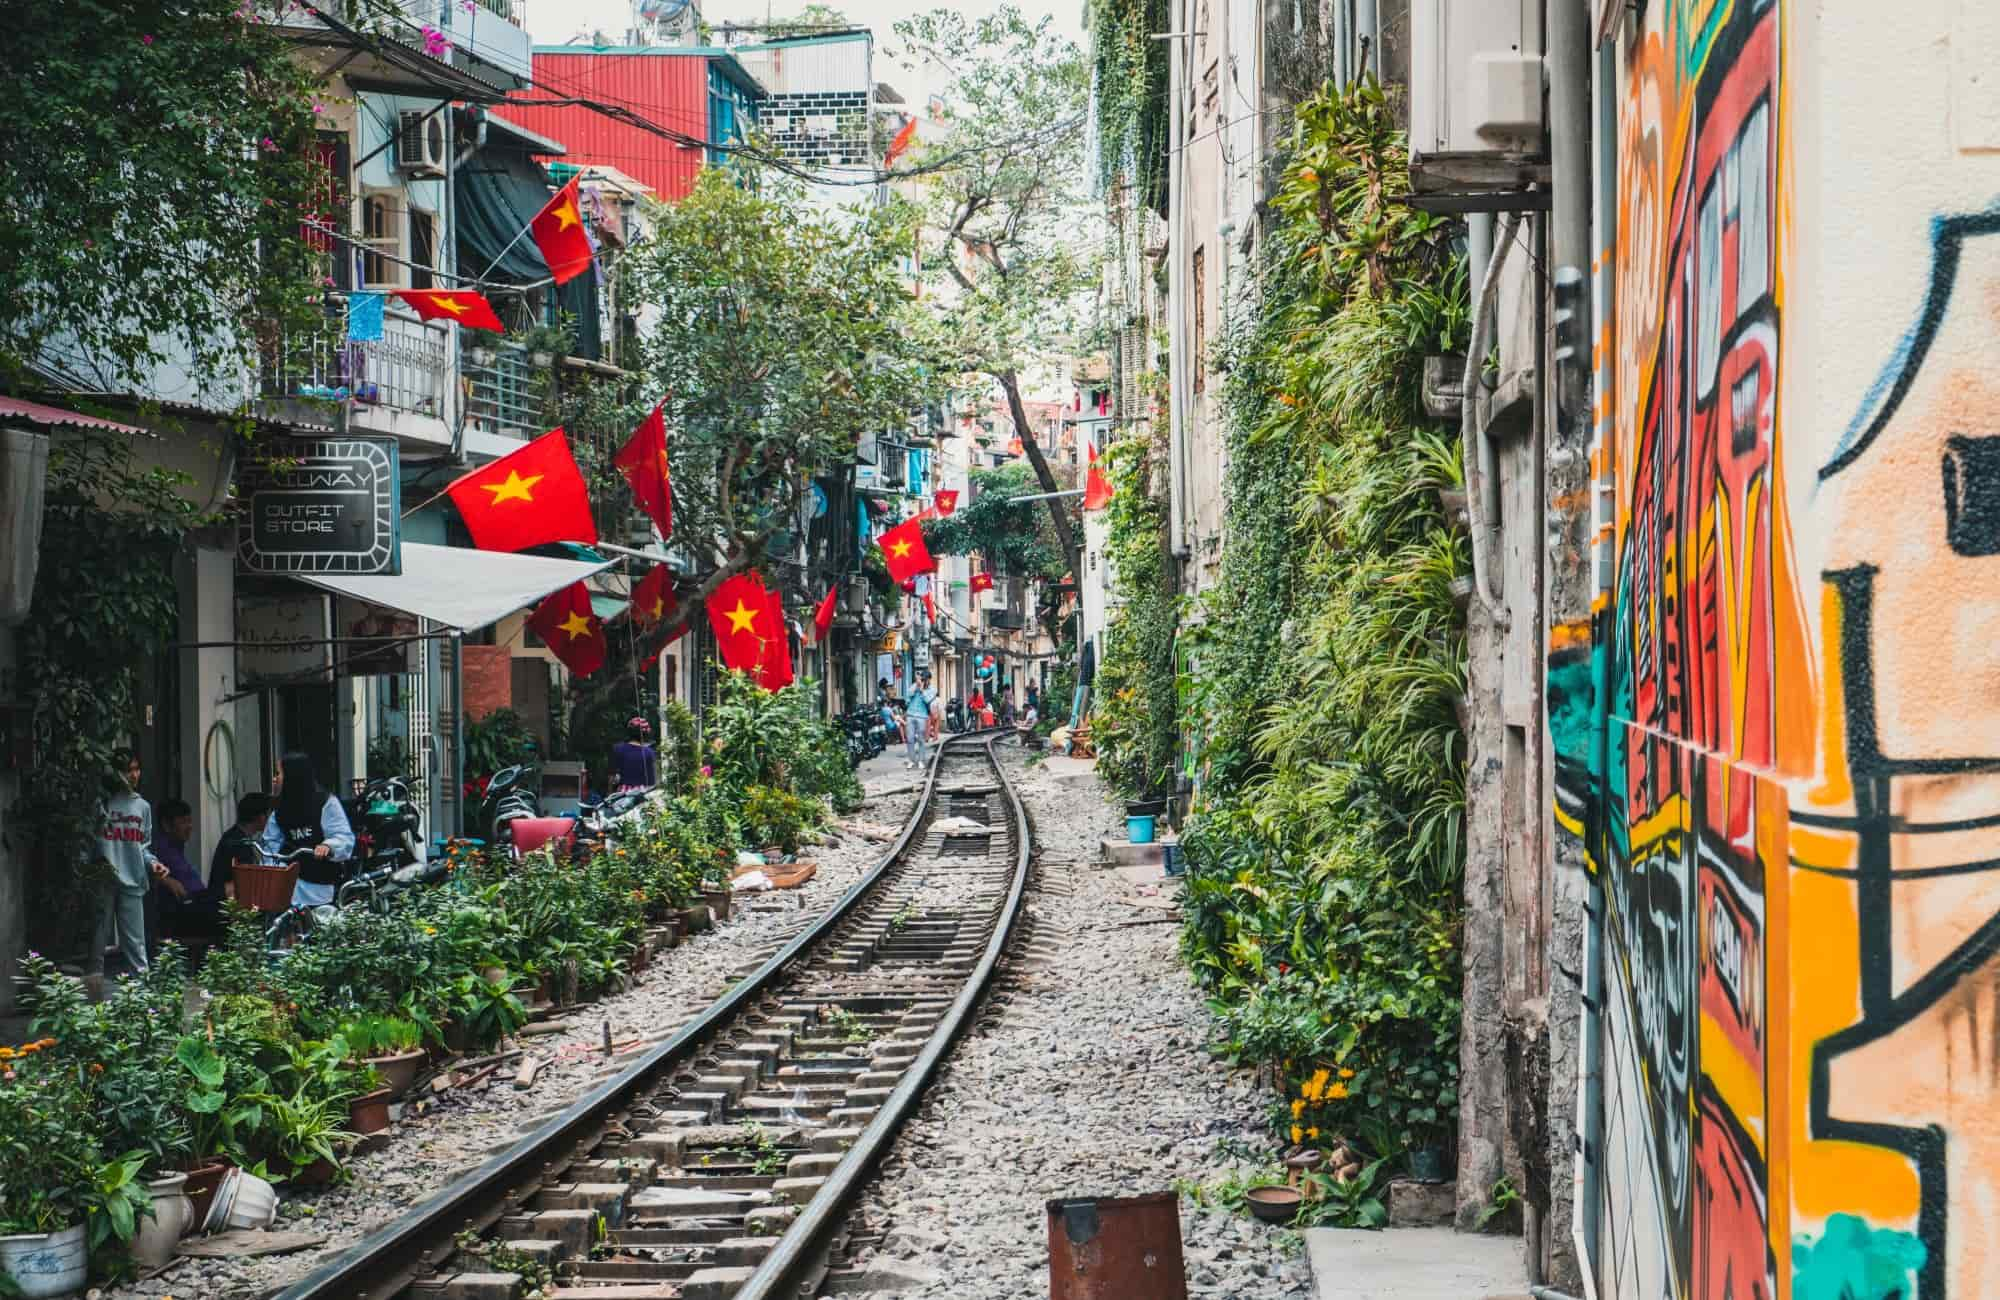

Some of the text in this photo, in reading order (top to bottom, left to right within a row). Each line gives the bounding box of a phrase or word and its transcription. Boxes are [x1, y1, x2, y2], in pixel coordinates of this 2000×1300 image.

[242, 472, 372, 488] AILWAY
[264, 503, 345, 518] OUTFIT
[264, 520, 336, 533] STORE
